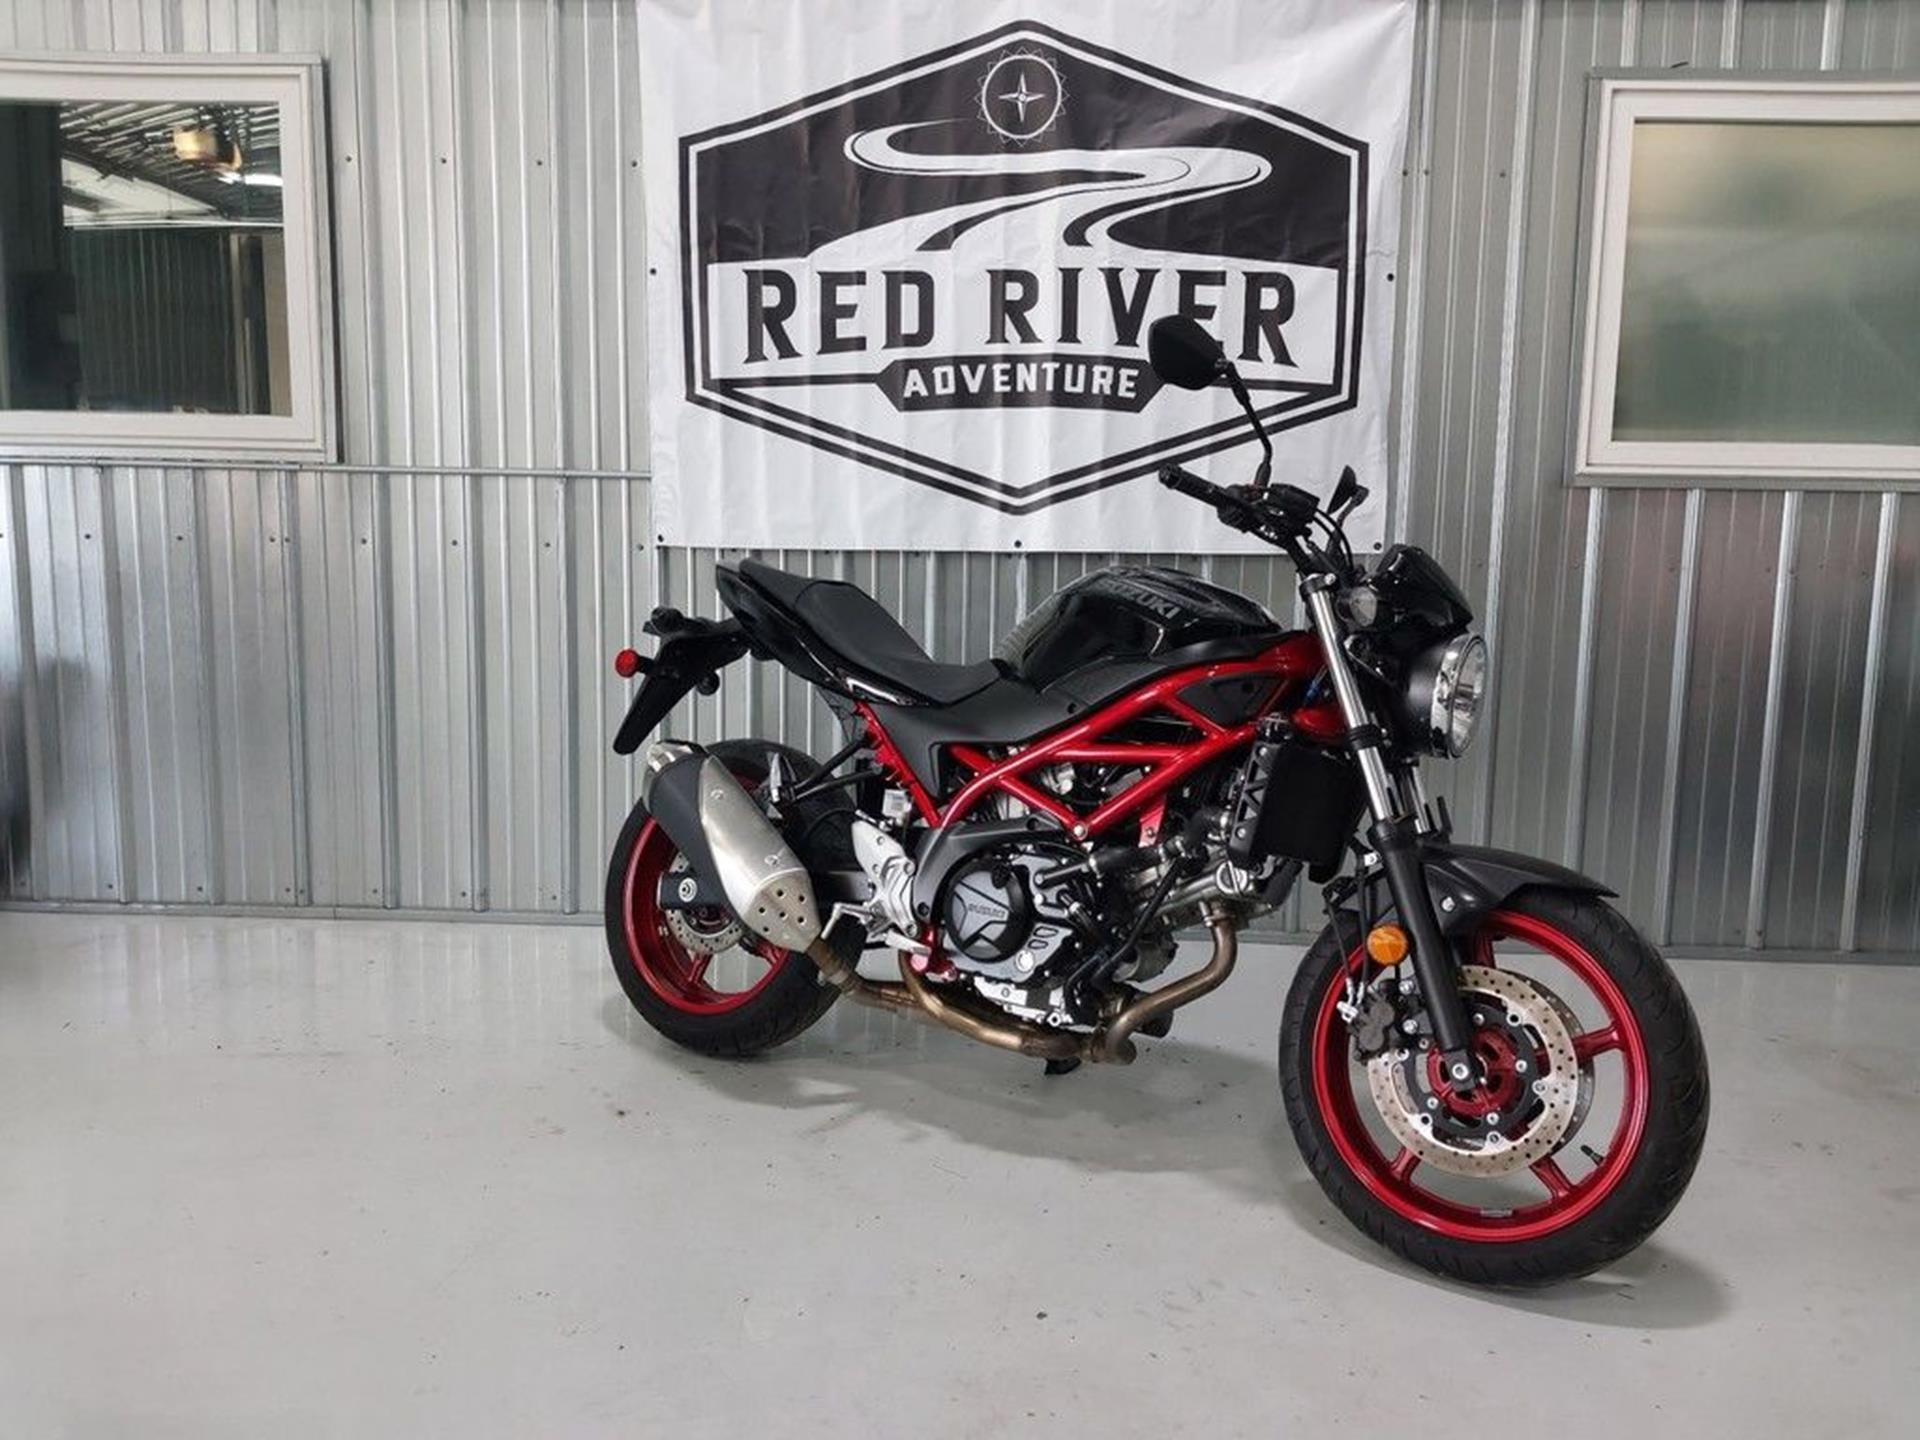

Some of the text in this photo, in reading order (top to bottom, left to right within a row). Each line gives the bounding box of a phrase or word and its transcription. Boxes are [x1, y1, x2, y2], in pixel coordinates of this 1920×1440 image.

[743, 267, 1298, 368] RED RIVER
[904, 361, 1139, 398] ADVENTURE
